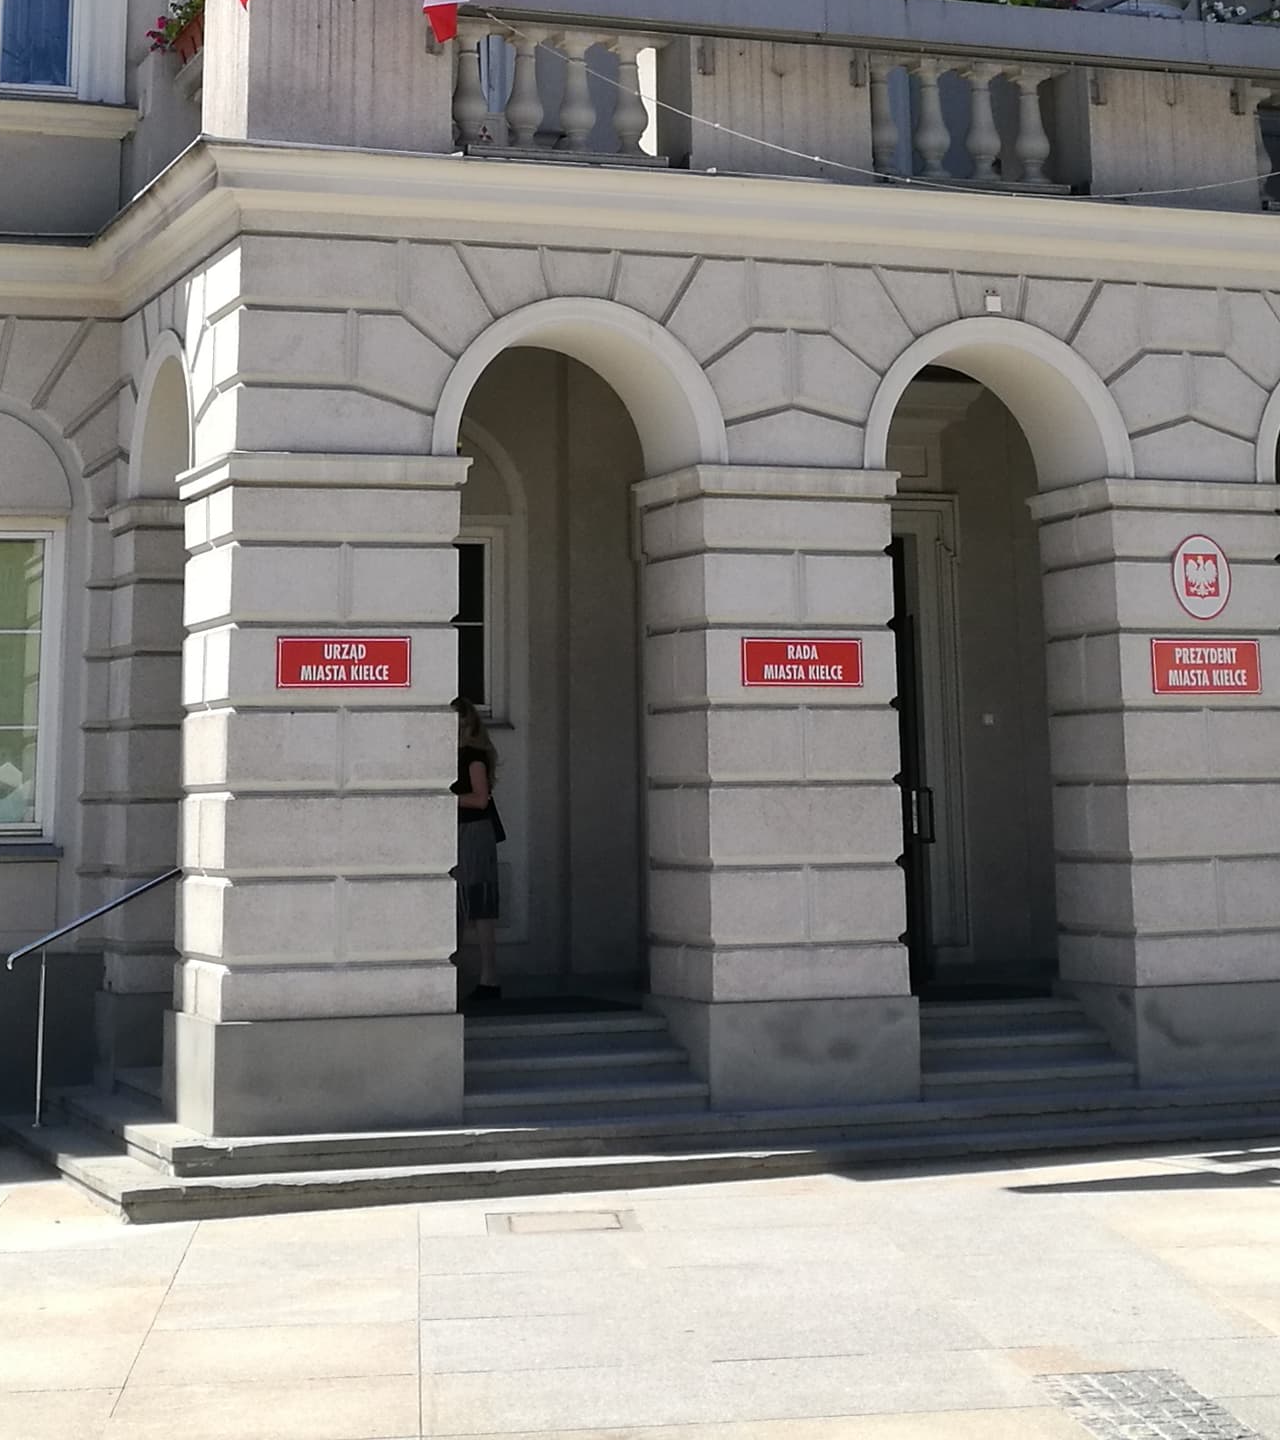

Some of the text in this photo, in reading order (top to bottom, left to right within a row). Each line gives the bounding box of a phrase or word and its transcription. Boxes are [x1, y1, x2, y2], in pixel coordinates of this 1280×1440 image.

[324, 643, 366, 663] URZĄD
[787, 644, 819, 660] RADA
[1174, 647, 1237, 665] PREZYDENT
[300, 665, 390, 681] MIASTA KIELCE
[763, 664, 843, 680] MIASTA KIELCE
[1168, 669, 1247, 686] MIASTA KIELCE
